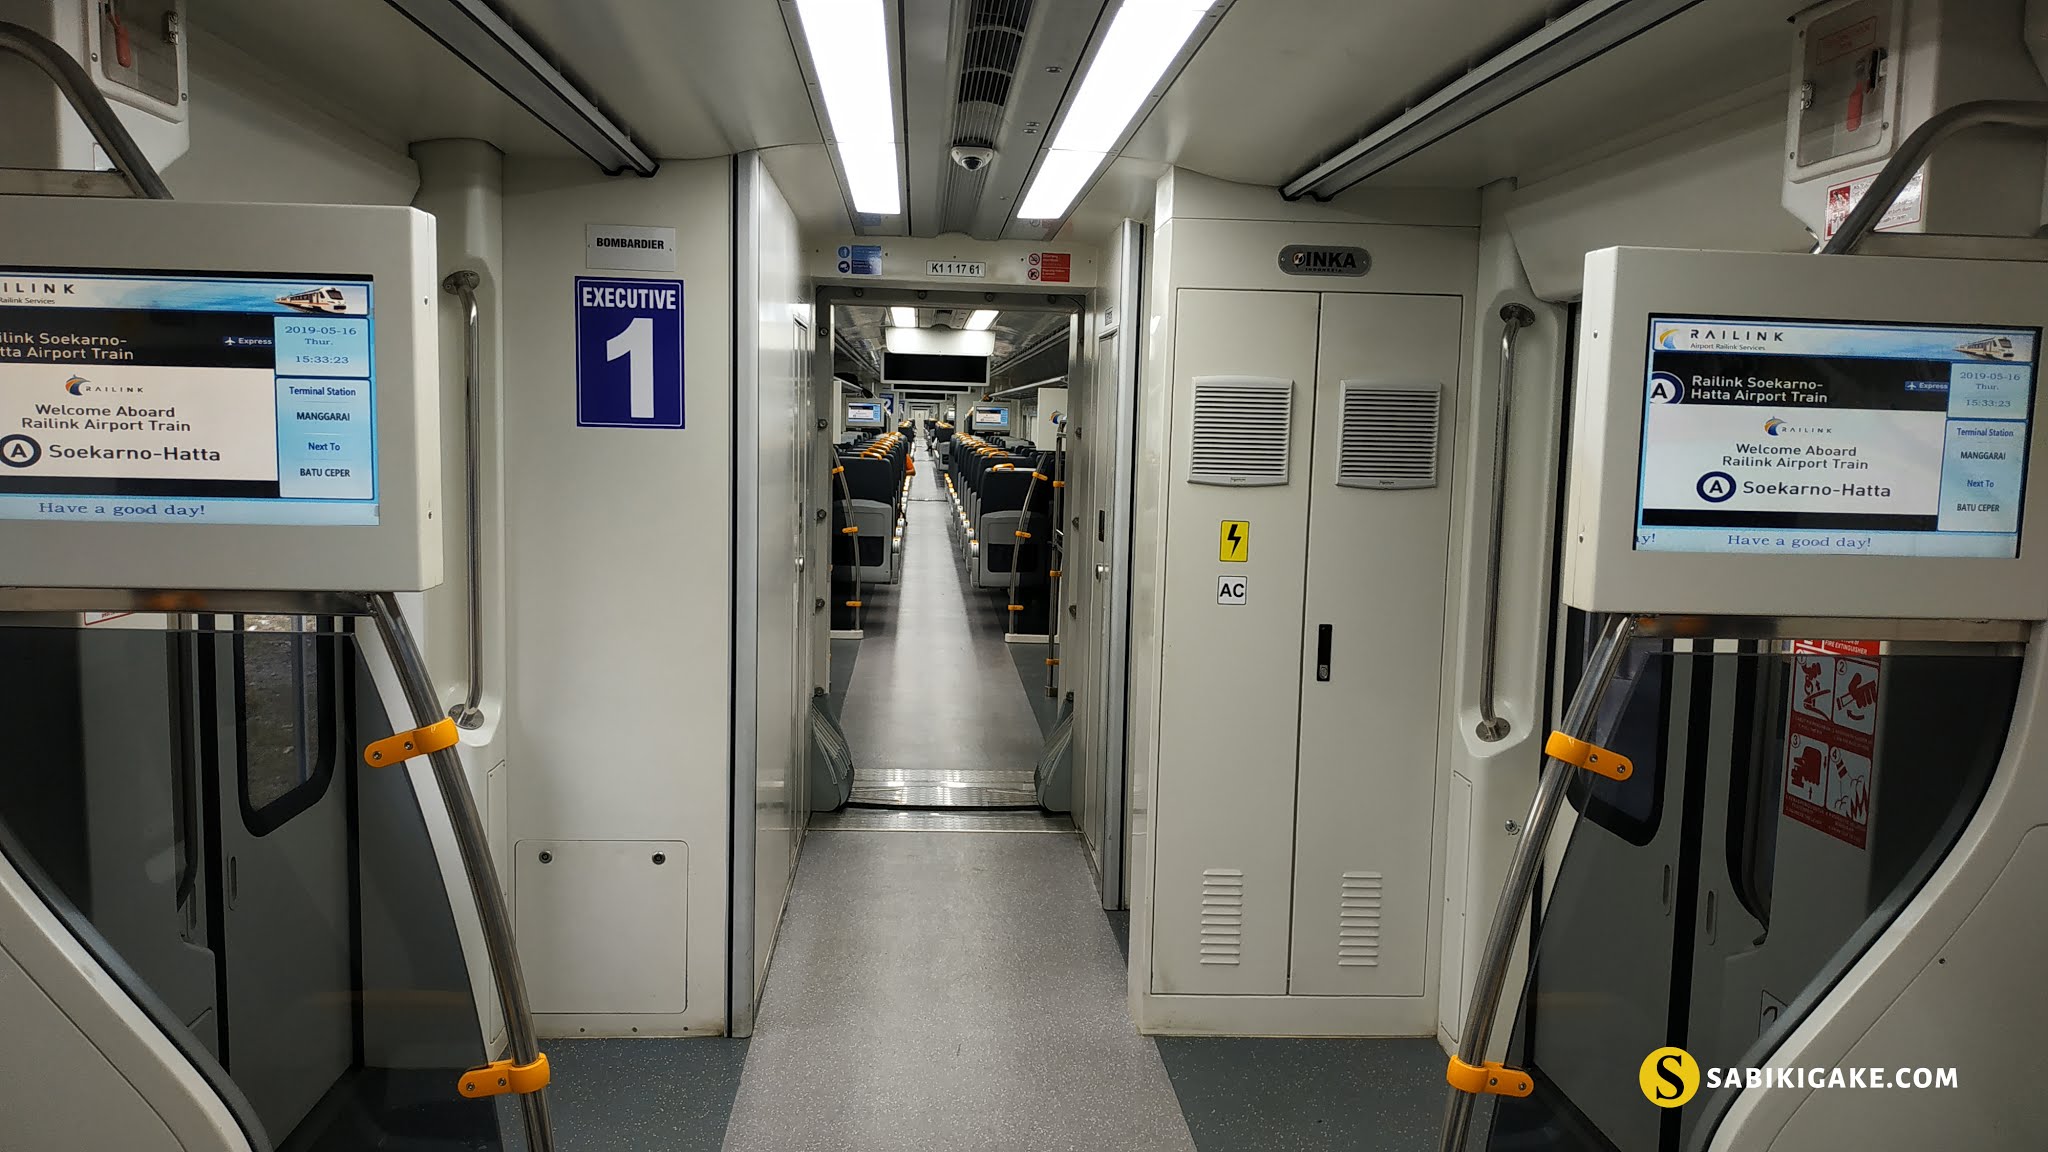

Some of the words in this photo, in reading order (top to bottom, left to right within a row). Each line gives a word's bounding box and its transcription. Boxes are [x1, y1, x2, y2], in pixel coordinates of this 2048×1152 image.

[596, 237, 665, 249] BOMBARDIER
[1305, 251, 1357, 268] INKA
[931, 263, 943, 273] K1
[947, 264, 952, 273] 1
[956, 264, 966, 274] 17
[969, 264, 980, 274] 61
[25, 297, 55, 305] Services
[582, 287, 676, 310] EXECUTIVE
[285, 326, 357, 335] 2019-05-16
[1690, 329, 1783, 342] RAILINK
[40, 333, 127, 346] Soekarno-
[238, 337, 272, 346] Express
[305, 338, 333, 346] Thur.
[1690, 342, 1714, 351] Airport
[1716, 343, 1737, 351] Railink
[27, 347, 86, 360] Airport
[91, 348, 134, 360] Train
[296, 356, 349, 364] 15:33:23
[606, 318, 655, 419] 1
[1960, 372, 2020, 381] 2019-05-16
[289, 386, 324, 396] Terminal
[327, 387, 356, 396] Station
[1651, 383, 1668, 399] A
[1692, 375, 1743, 388] Railink
[1747, 377, 1823, 390] Soekarno-
[1919, 382, 1948, 390] Express
[1691, 388, 1731, 400] Hatta
[1735, 389, 1787, 403] Airport
[1791, 391, 1827, 403] Train
[1966, 399, 2011, 407] 15:33:23
[35, 404, 111, 416] Welcome
[116, 406, 175, 418] Aboard
[296, 412, 350, 421] MANGGARAI
[22, 418, 79, 430] Railink
[84, 419, 143, 432] Airport
[149, 420, 190, 432] Train
[1957, 428, 1987, 437] Terminal
[1989, 428, 2014, 437] Station
[10, 443, 28, 458] A
[49, 444, 220, 461] Soekarno-Hatta
[308, 442, 327, 451] Next
[330, 442, 340, 451] To
[1736, 443, 1801, 455] Welcome
[1806, 445, 1857, 457] Aboard
[1960, 451, 2006, 460] MANGGARAI
[1722, 456, 1772, 467] Railink
[1776, 457, 1828, 470] Airport
[1832, 459, 1868, 470] Train
[300, 468, 322, 477] BATU
[325, 468, 350, 477] CEPER
[1709, 479, 1724, 494] A
[1743, 481, 1891, 497] Soekarno-Hatta
[1967, 479, 1983, 488] Next
[1985, 480, 1995, 488] To
[39, 502, 88, 513] Have
[95, 505, 105, 514] a
[113, 505, 157, 517] good
[164, 505, 204, 517] day!
[1957, 503, 1976, 512] BATU
[1978, 504, 2000, 512] CEPER
[1727, 535, 1770, 546] Have
[1776, 538, 1785, 546] a
[1791, 537, 1830, 548] good
[1836, 537, 1871, 549] day!
[1219, 583, 1245, 599] AC
[1824, 639, 1835, 648] FIRE
[1835, 641, 1868, 656] EXTINGUISHER
[1839, 661, 1845, 673] 2
[1793, 735, 1798, 746] 3
